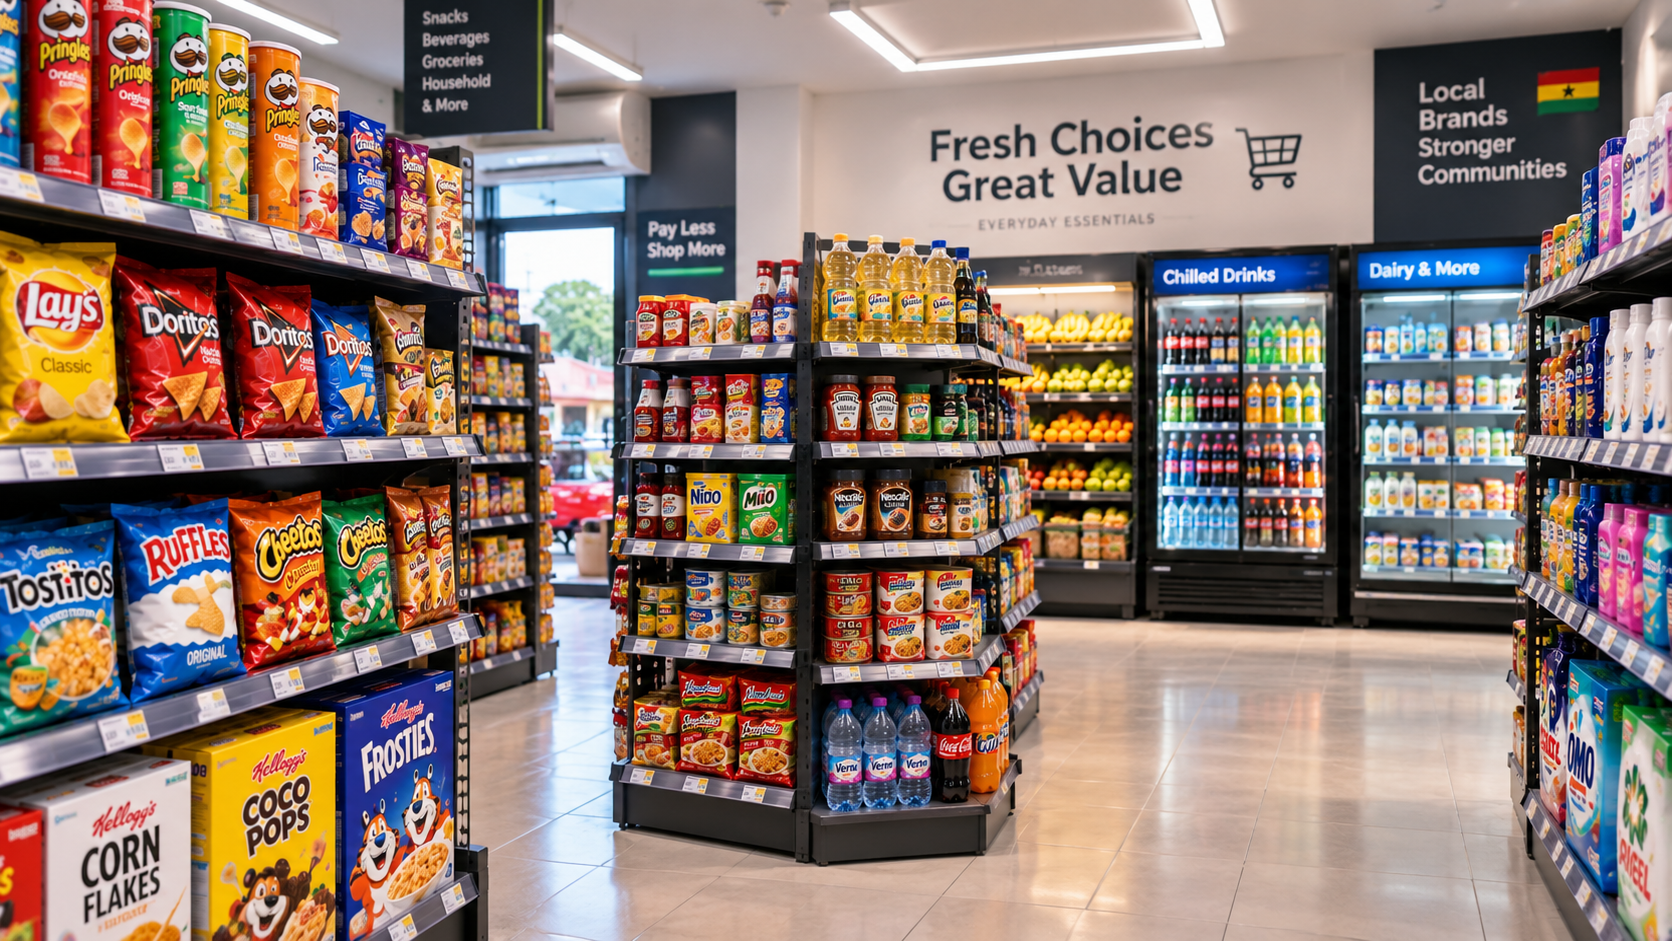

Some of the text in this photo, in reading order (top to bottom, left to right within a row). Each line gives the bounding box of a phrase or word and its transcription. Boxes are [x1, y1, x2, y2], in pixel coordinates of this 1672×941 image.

[422, 9, 469, 25] Snacks
[422, 31, 490, 48] Beverages
[422, 52, 484, 69] Groceries
[422, 73, 491, 91] Household
[1419, 77, 1485, 104] Local
[422, 98, 469, 113] & More
[1419, 104, 1508, 131] Brands
[930, 116, 1214, 162] Fresh Choices
[1418, 136, 1516, 160] Stronger
[943, 160, 1182, 202] Great Value
[1418, 158, 1568, 186] Communities
[648, 219, 716, 241] Pay Less
[978, 213, 1156, 230] EVERYDAY ESSENTIALS
[647, 241, 726, 261] Shop More
[1163, 266, 1276, 285] Chilled Drinks
[1369, 260, 1480, 281] Dairy & More
[24, 282, 101, 333] Lay's
[141, 305, 220, 339] Doritos
[253, 320, 314, 350] Doritos
[325, 333, 373, 358] Doritos
[41, 357, 92, 374] Classic
[143, 524, 231, 582] RUFFLES
[258, 517, 322, 579] Cheetos
[187, 644, 227, 666] ORIGINAL
[252, 748, 308, 783] Kellogg's
[361, 712, 435, 793] FROSTIES
[1568, 732, 1594, 790] OMO
[243, 775, 310, 827] COCO
[92, 800, 157, 838] Kellogg's
[246, 801, 310, 857] POPS
[81, 824, 160, 888] CORN
[84, 866, 160, 924] FLAKES
